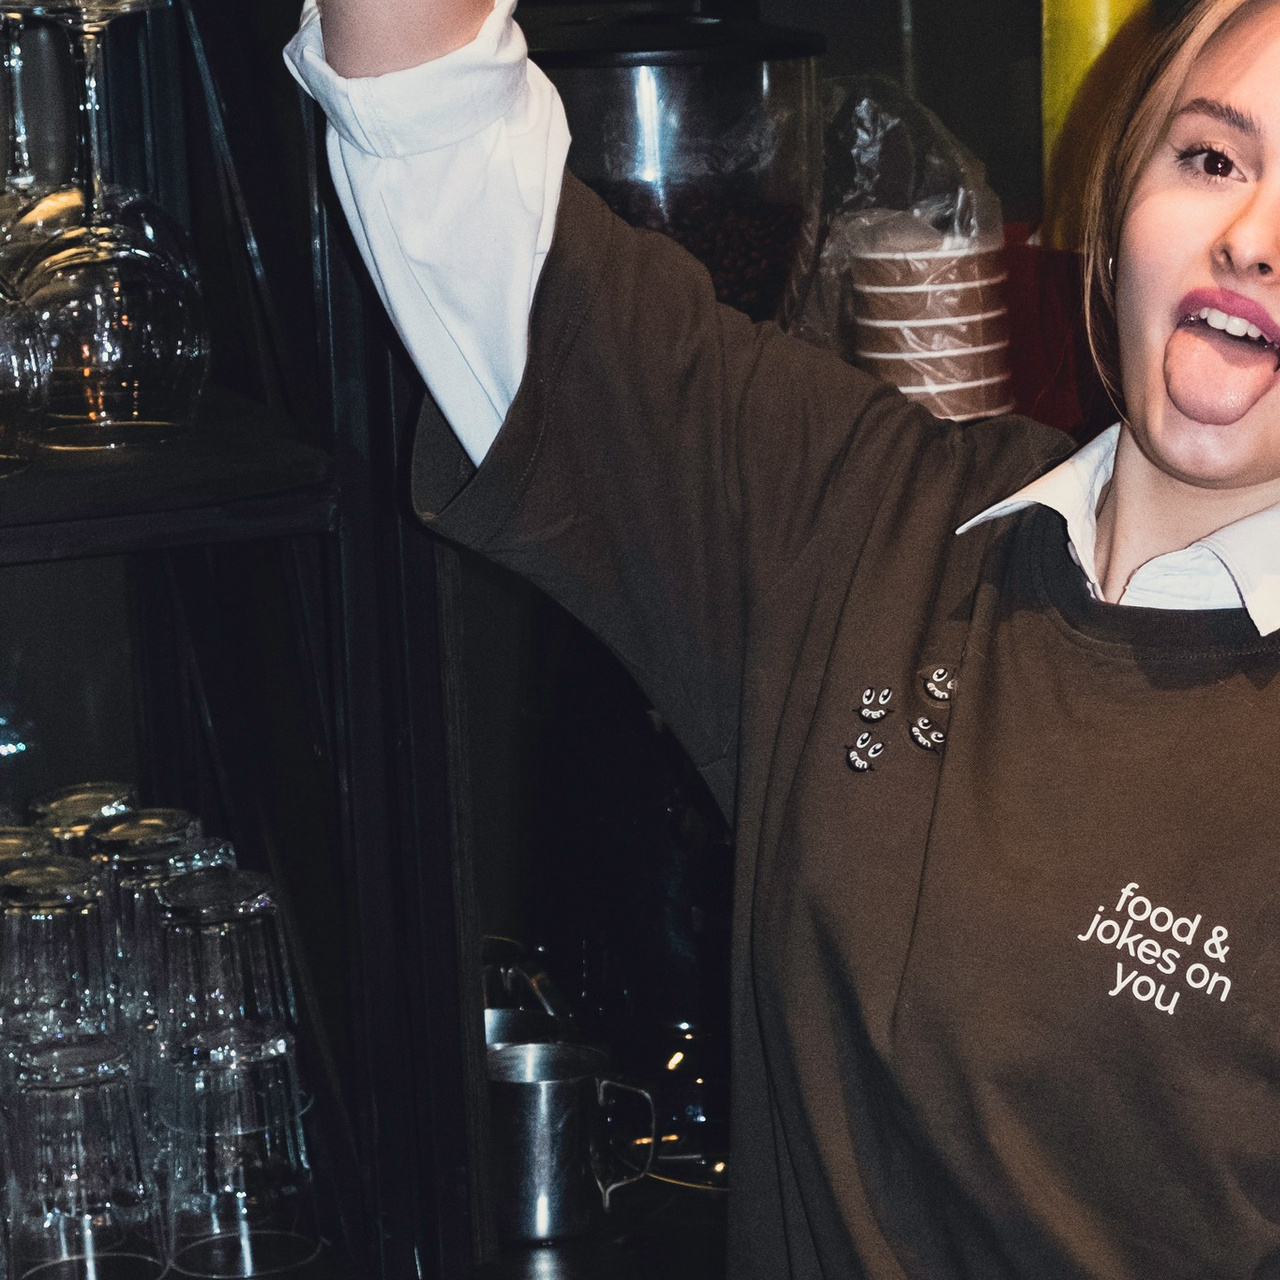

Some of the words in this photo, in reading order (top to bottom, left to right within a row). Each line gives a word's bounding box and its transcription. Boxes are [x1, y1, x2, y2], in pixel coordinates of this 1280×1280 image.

[1077, 905, 1181, 975] jokes
[1185, 962, 1232, 1002] on
[1115, 882, 1202, 946] food
[1203, 925, 1230, 963] &
[1108, 962, 1181, 1016] you
